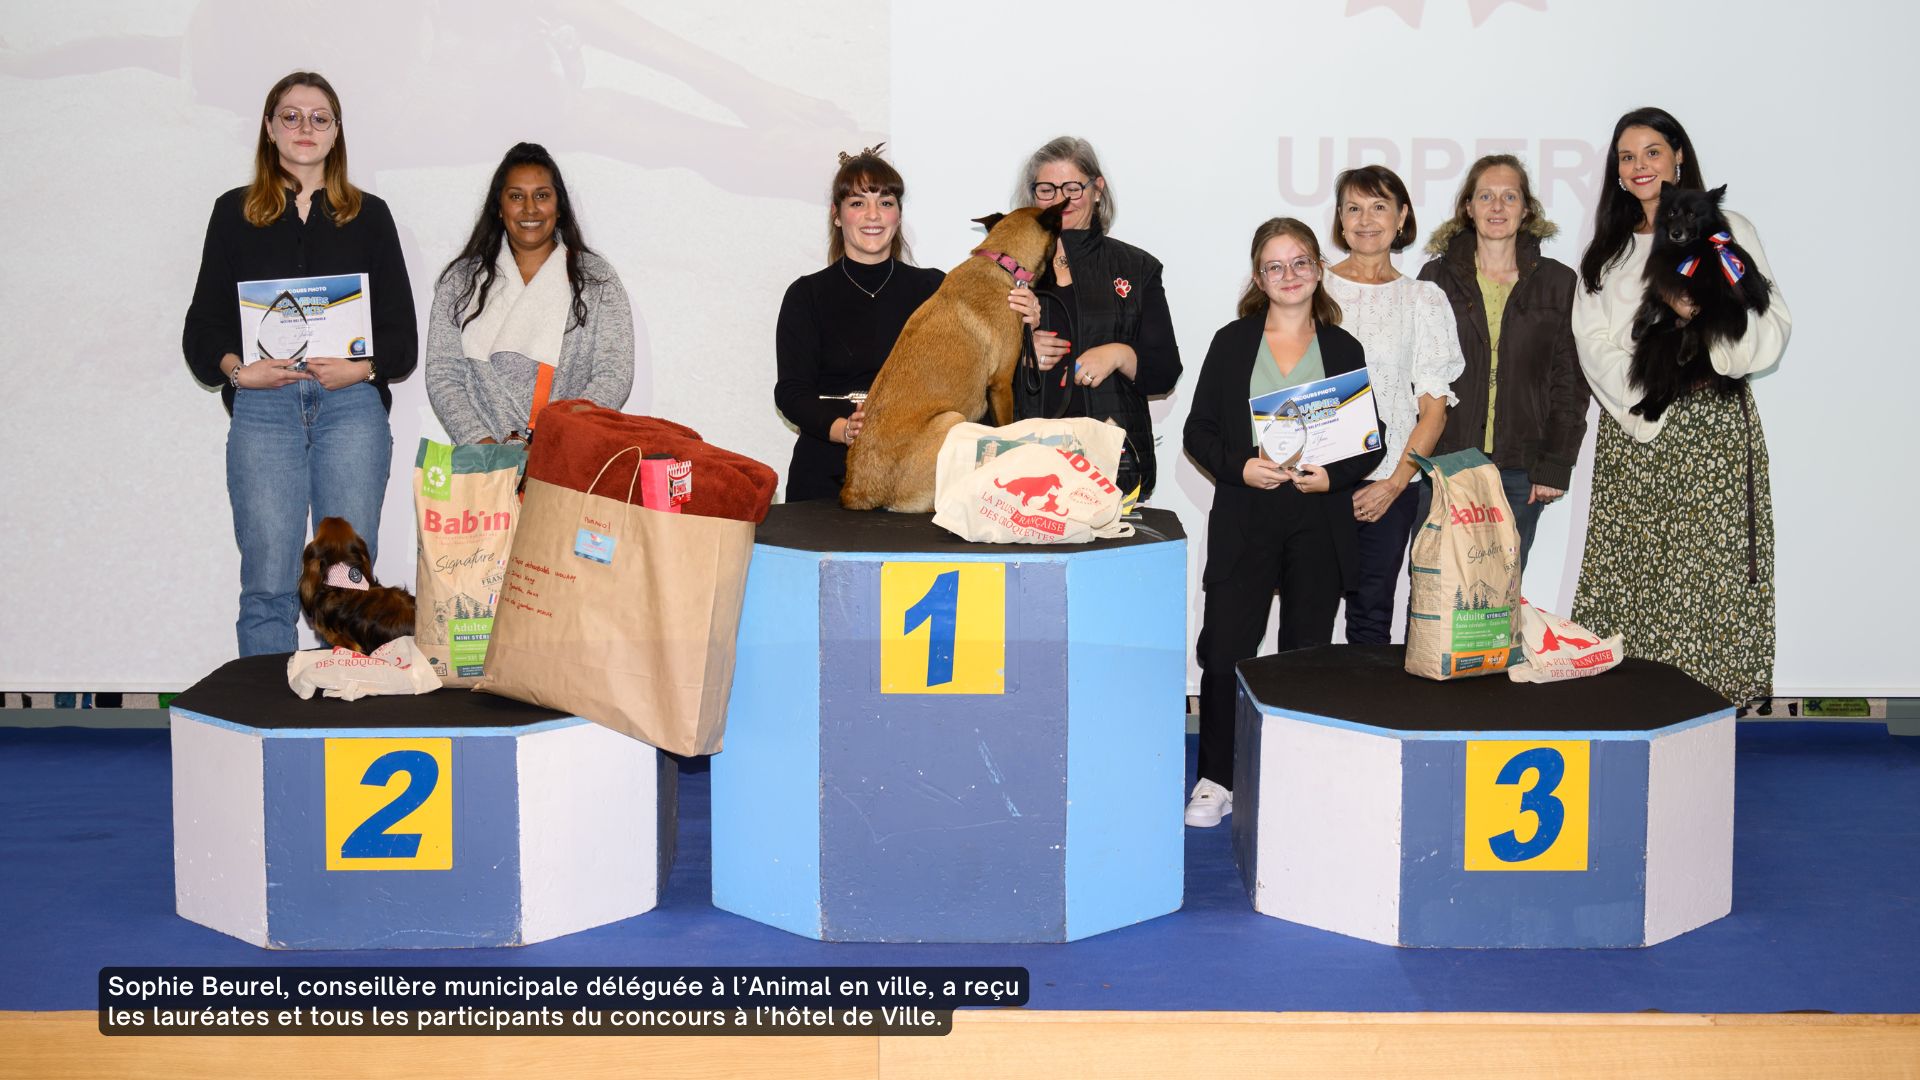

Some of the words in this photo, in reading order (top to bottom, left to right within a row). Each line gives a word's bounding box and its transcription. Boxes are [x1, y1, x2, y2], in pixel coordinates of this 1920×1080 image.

[424, 508, 511, 535] Bab'in
[979, 505, 999, 522] DES
[981, 491, 994, 504] LA
[994, 499, 1016, 515] PLUS
[1012, 511, 1065, 533] FRANÇAISE
[1450, 501, 1505, 526] Bab'in
[433, 547, 495, 575] Signature
[481, 573, 504, 586] FRAN
[454, 622, 488, 633] Adulte
[1456, 612, 1486, 622] Adulte
[471, 633, 491, 641] STÉRI
[904, 570, 959, 687] 1
[315, 658, 335, 669] DES
[1551, 669, 1565, 679] DES
[341, 750, 439, 858] 2
[1488, 747, 1564, 862] 3
